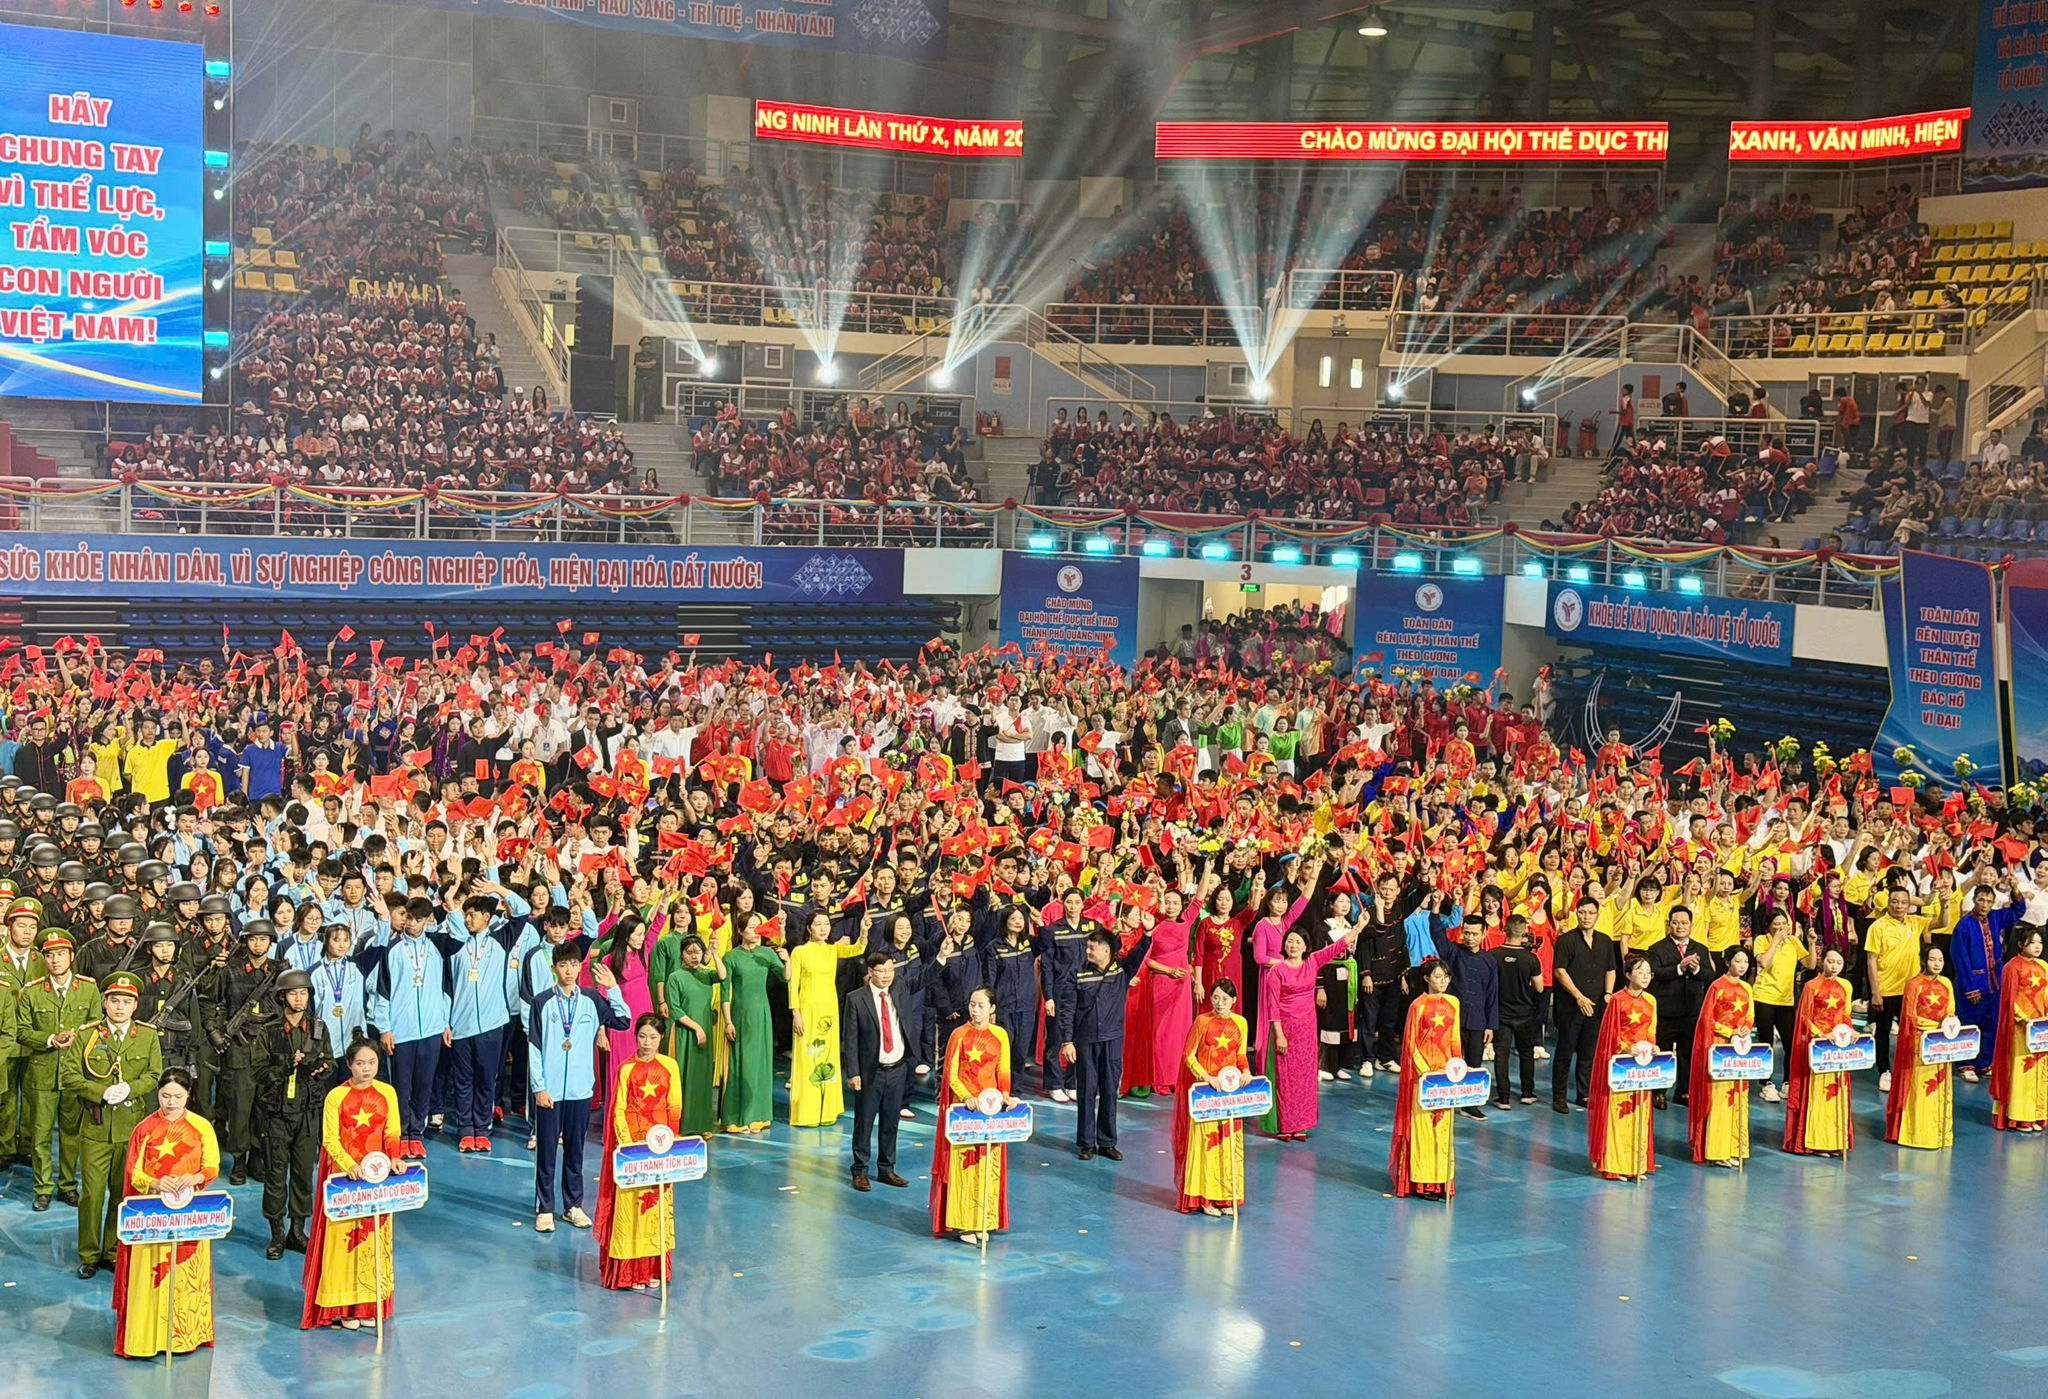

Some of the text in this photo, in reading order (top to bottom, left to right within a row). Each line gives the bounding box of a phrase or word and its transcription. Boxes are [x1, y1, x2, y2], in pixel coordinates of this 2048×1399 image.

[688, 1, 712, 25] TRÍ
[715, 5, 743, 32] TUỆ
[756, 8, 797, 34] NHÂN
[800, 12, 835, 38] VĂN!
[49, 91, 113, 128] HÃY
[755, 108, 787, 130] NG
[792, 112, 839, 135] NINH
[887, 120, 929, 142] THỨ
[931, 127, 950, 149] X,
[954, 125, 999, 147] NĂM
[1730, 119, 1958, 154] XANH, VĂN MINH, HIỆN
[1300, 126, 1363, 150] CHÀO
[1368, 127, 1436, 151] MỪNG
[1441, 130, 1478, 155] ĐẠI
[1484, 129, 1522, 156] HỘI
[1578, 131, 1628, 156] DỤC
[0, 133, 164, 175] CHUNG TAY
[0, 172, 165, 221] VÌ THỂ LỰC,
[10, 215, 149, 259] TẦM VÓC
[0, 266, 164, 302] CON NGƯỜI
[0, 305, 158, 346] VIỆT NAM!
[0, 541, 763, 593] SỨC KHỎE NHÂN DÂN, VÌ SỰ NGHIỆP CÔNG NGHIỆP HÓA, HIỆN ĐẠI HÓA ĐẤT NƯỚC!
[1240, 563, 1252, 581] 3
[1045, 596, 1093, 611] CHÀO MỪNG
[1018, 610, 1119, 628] ĐẠI HỘI THỂ DỤC THỂ THAO
[1403, 616, 1453, 631] TOÀN DÂN
[1588, 594, 1781, 649] KHỎE ĐỂ XÂY DỰNG VÀ BẢO VỆ TỔ QUỐC!
[1920, 606, 1979, 626] TOÀN DÂN
[1021, 625, 1047, 638] THÀNH
[1049, 625, 1066, 639] PHỐ
[1066, 626, 1094, 642] QUẢNG
[1376, 630, 1480, 649] RÈN LUYỆN THÂN THỂ
[1915, 626, 1980, 649] RÈN LUYỆN
[1396, 649, 1457, 663] THEO GƯƠNG
[1920, 647, 1978, 669] THÂN THỂ
[1391, 663, 1410, 676] BC
[1909, 667, 1981, 690] THEO GƯƠNG
[1921, 688, 1965, 709] BÁC HỒ
[1936, 712, 1961, 730] ĐẠI!
[1637, 1070, 1646, 1079] BA
[1196, 1096, 1207, 1109] KHỐI
[1208, 1095, 1221, 1108] CÔNG
[1222, 1093, 1236, 1106] NHÂN
[1254, 1092, 1267, 1102] THAN
[640, 1157, 664, 1171] THÀNH
[666, 1154, 681, 1168] TÍCH
[683, 1155, 698, 1166] CAO
[332, 1181, 420, 1206] KHỐI CẢNH SÁT CƠ ĐỘNG
[125, 1206, 227, 1229] KHỐI CÔNG AN THÀNH PHỐ
